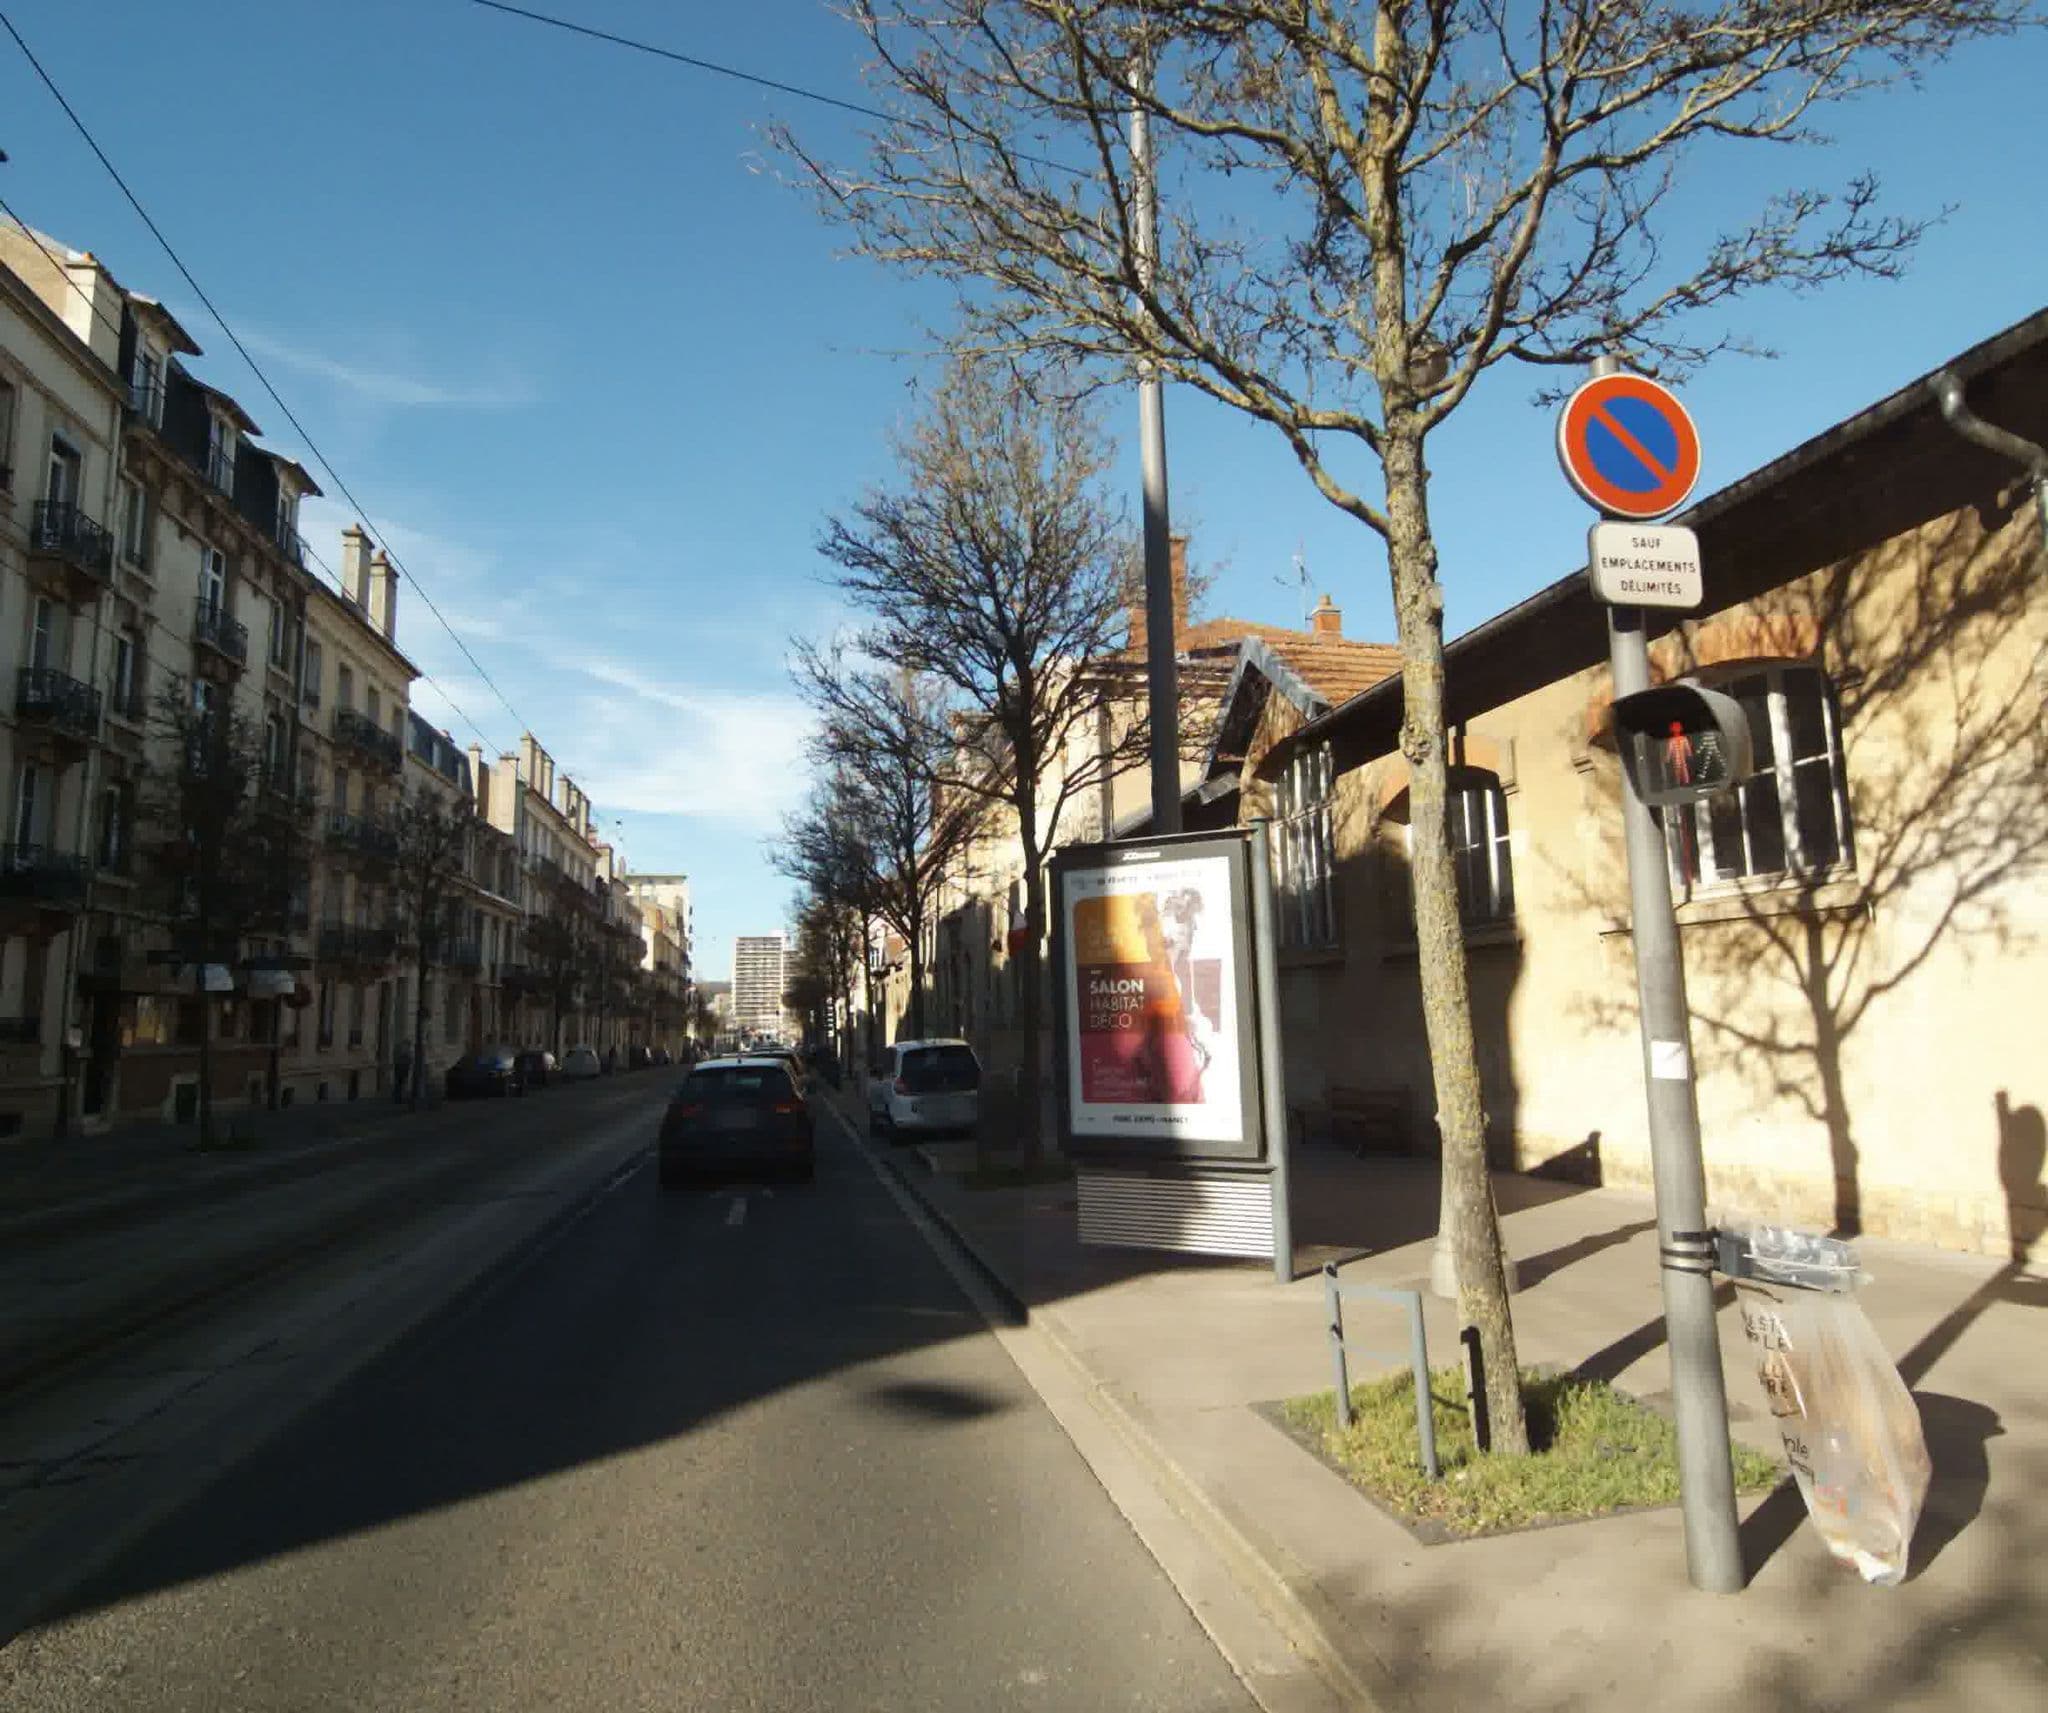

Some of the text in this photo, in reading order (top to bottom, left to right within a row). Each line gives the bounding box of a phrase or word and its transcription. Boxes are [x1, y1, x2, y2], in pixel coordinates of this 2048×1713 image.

[1632, 537, 1662, 549] SAUF
[1601, 557, 1697, 573] EMPLACEMENTS
[1089, 977, 1144, 995] SALON
